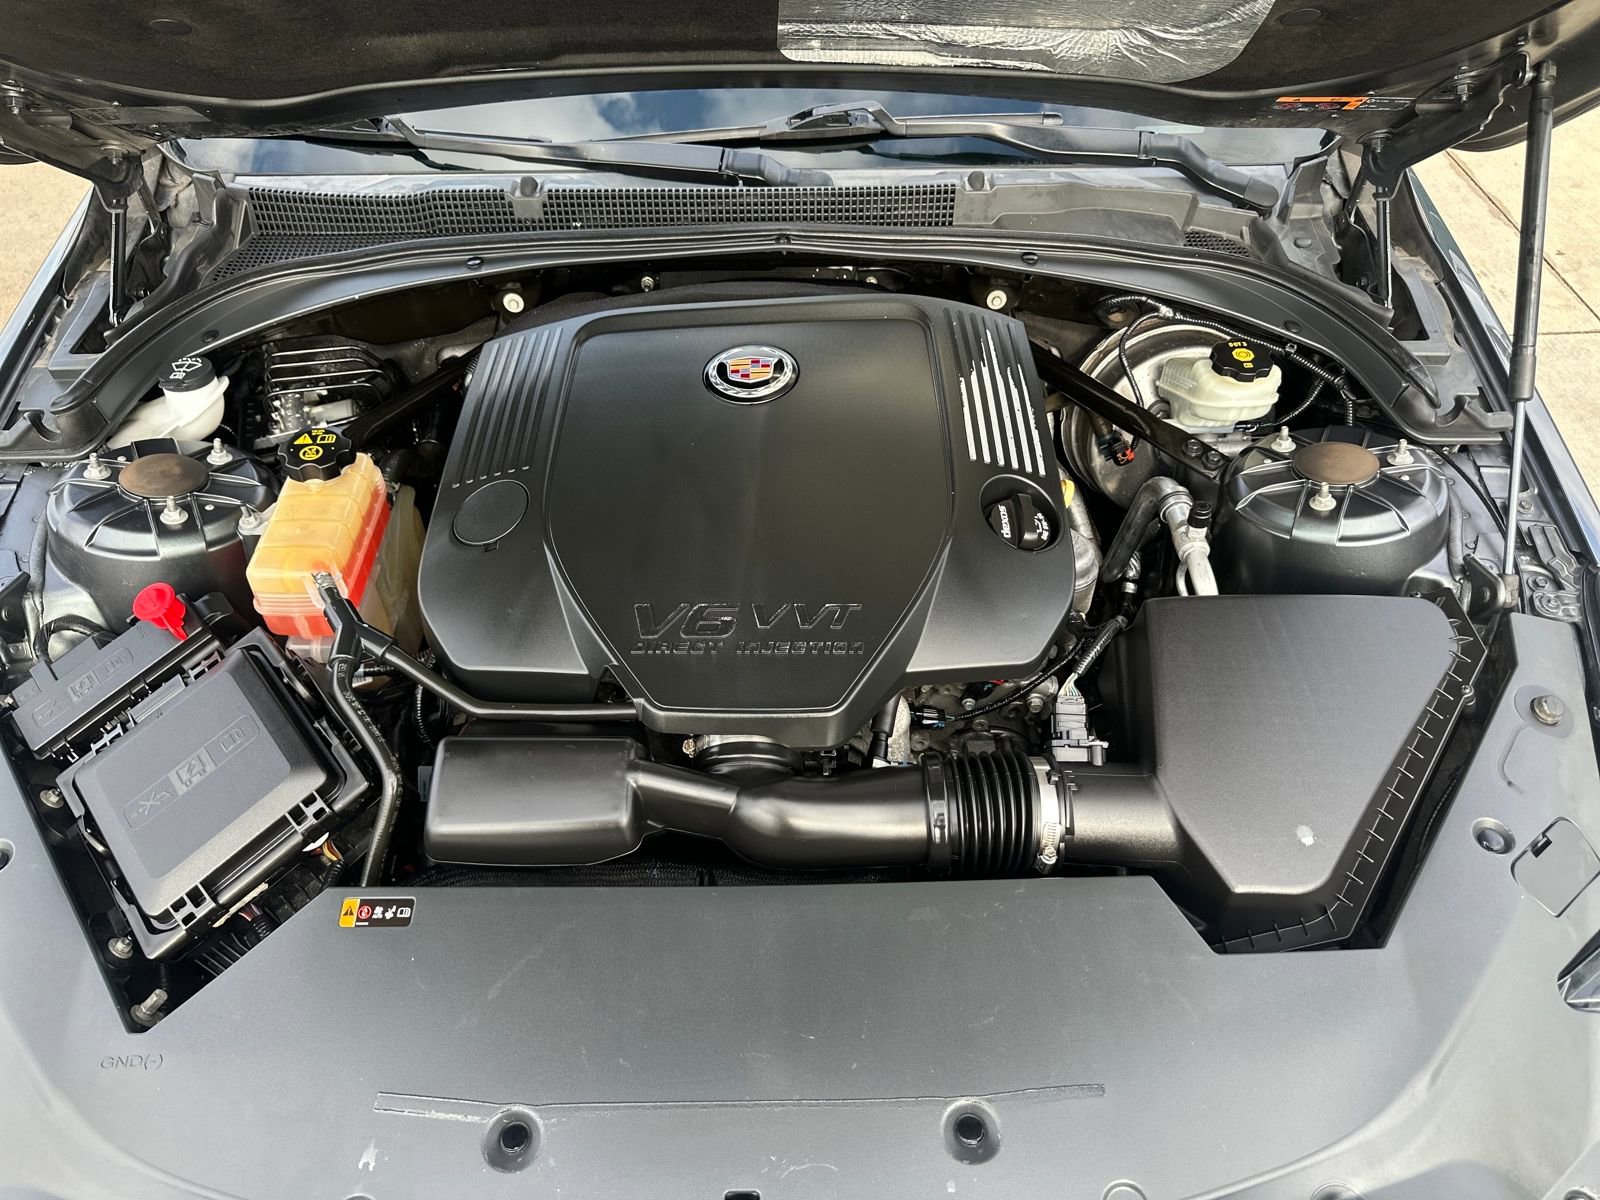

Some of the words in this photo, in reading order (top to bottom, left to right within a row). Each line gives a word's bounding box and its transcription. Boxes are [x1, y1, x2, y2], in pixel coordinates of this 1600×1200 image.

[998, 504, 1011, 539] dexos
[633, 603, 741, 639] V6
[752, 603, 862, 630] VVT
[631, 641, 724, 655] DIRECT
[736, 641, 865, 656] INJECTION
[100, 1053, 163, 1070] GND(-)
